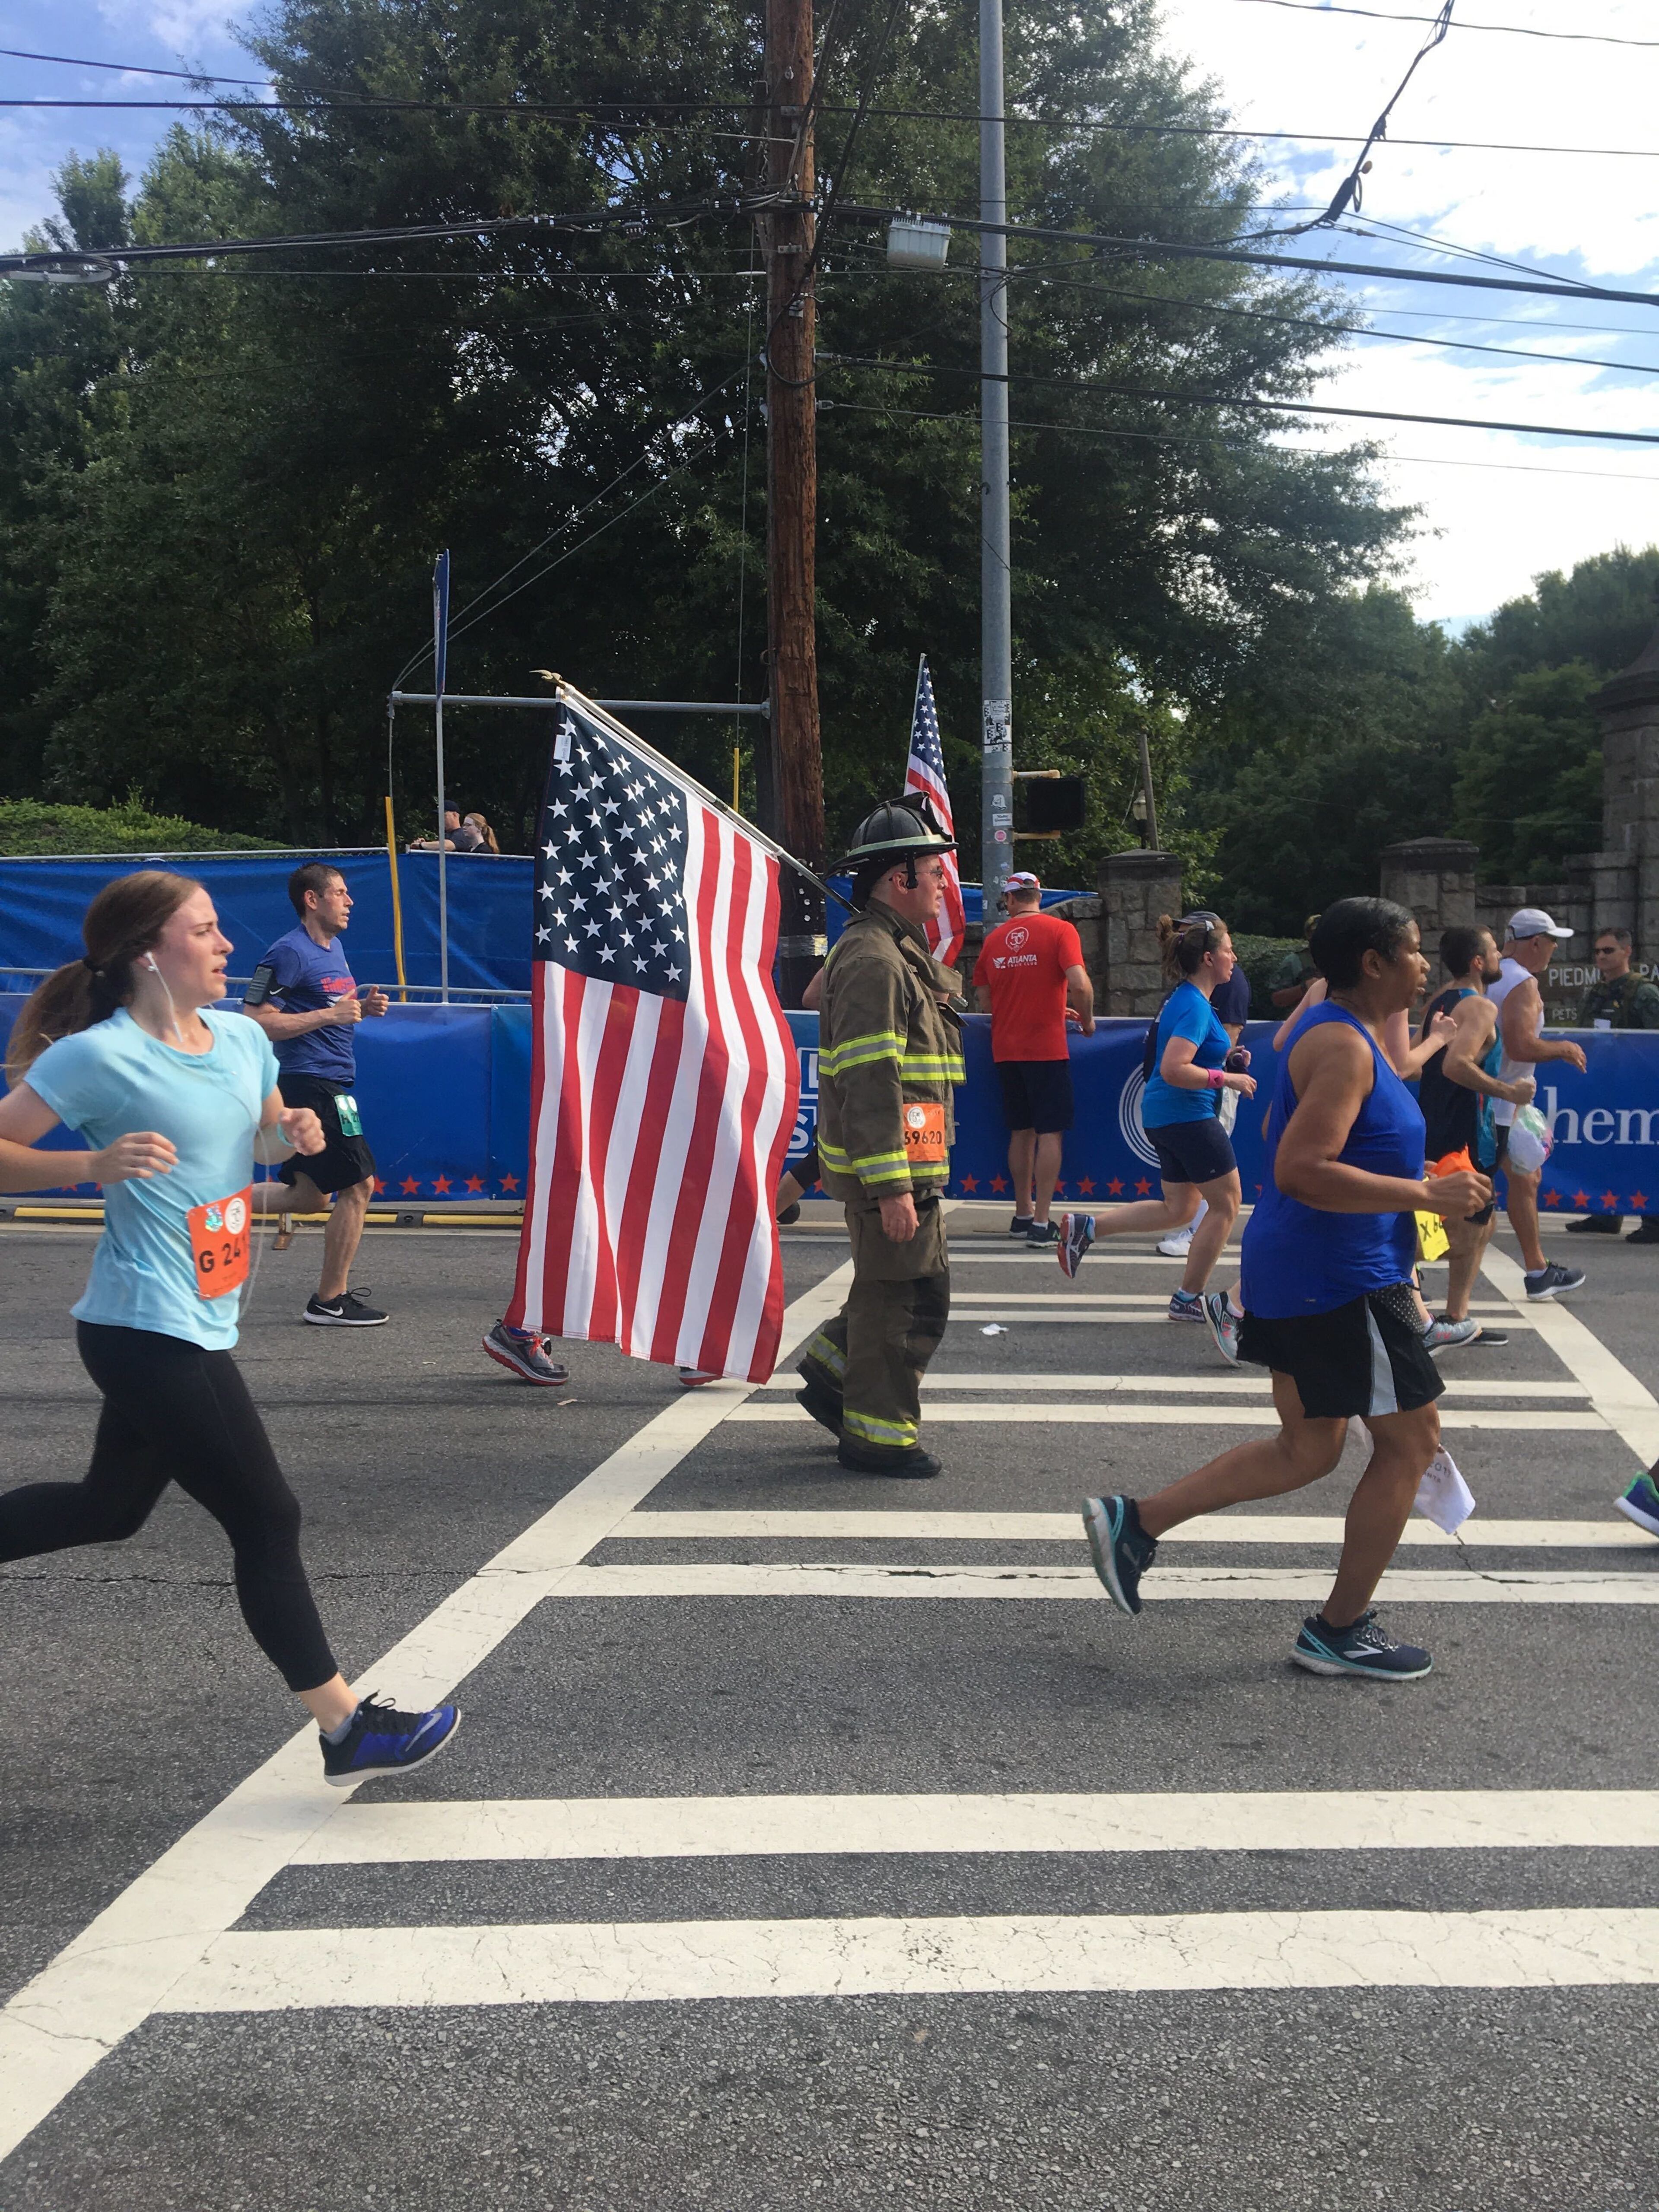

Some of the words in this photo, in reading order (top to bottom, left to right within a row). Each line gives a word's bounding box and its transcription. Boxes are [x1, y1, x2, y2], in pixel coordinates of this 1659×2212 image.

[1007, 954, 1037, 964] ATLANTA
[1549, 967, 1600, 987] PIEDM
[1420, 1220, 1432, 1242] X
[199, 1250, 215, 1273] G
